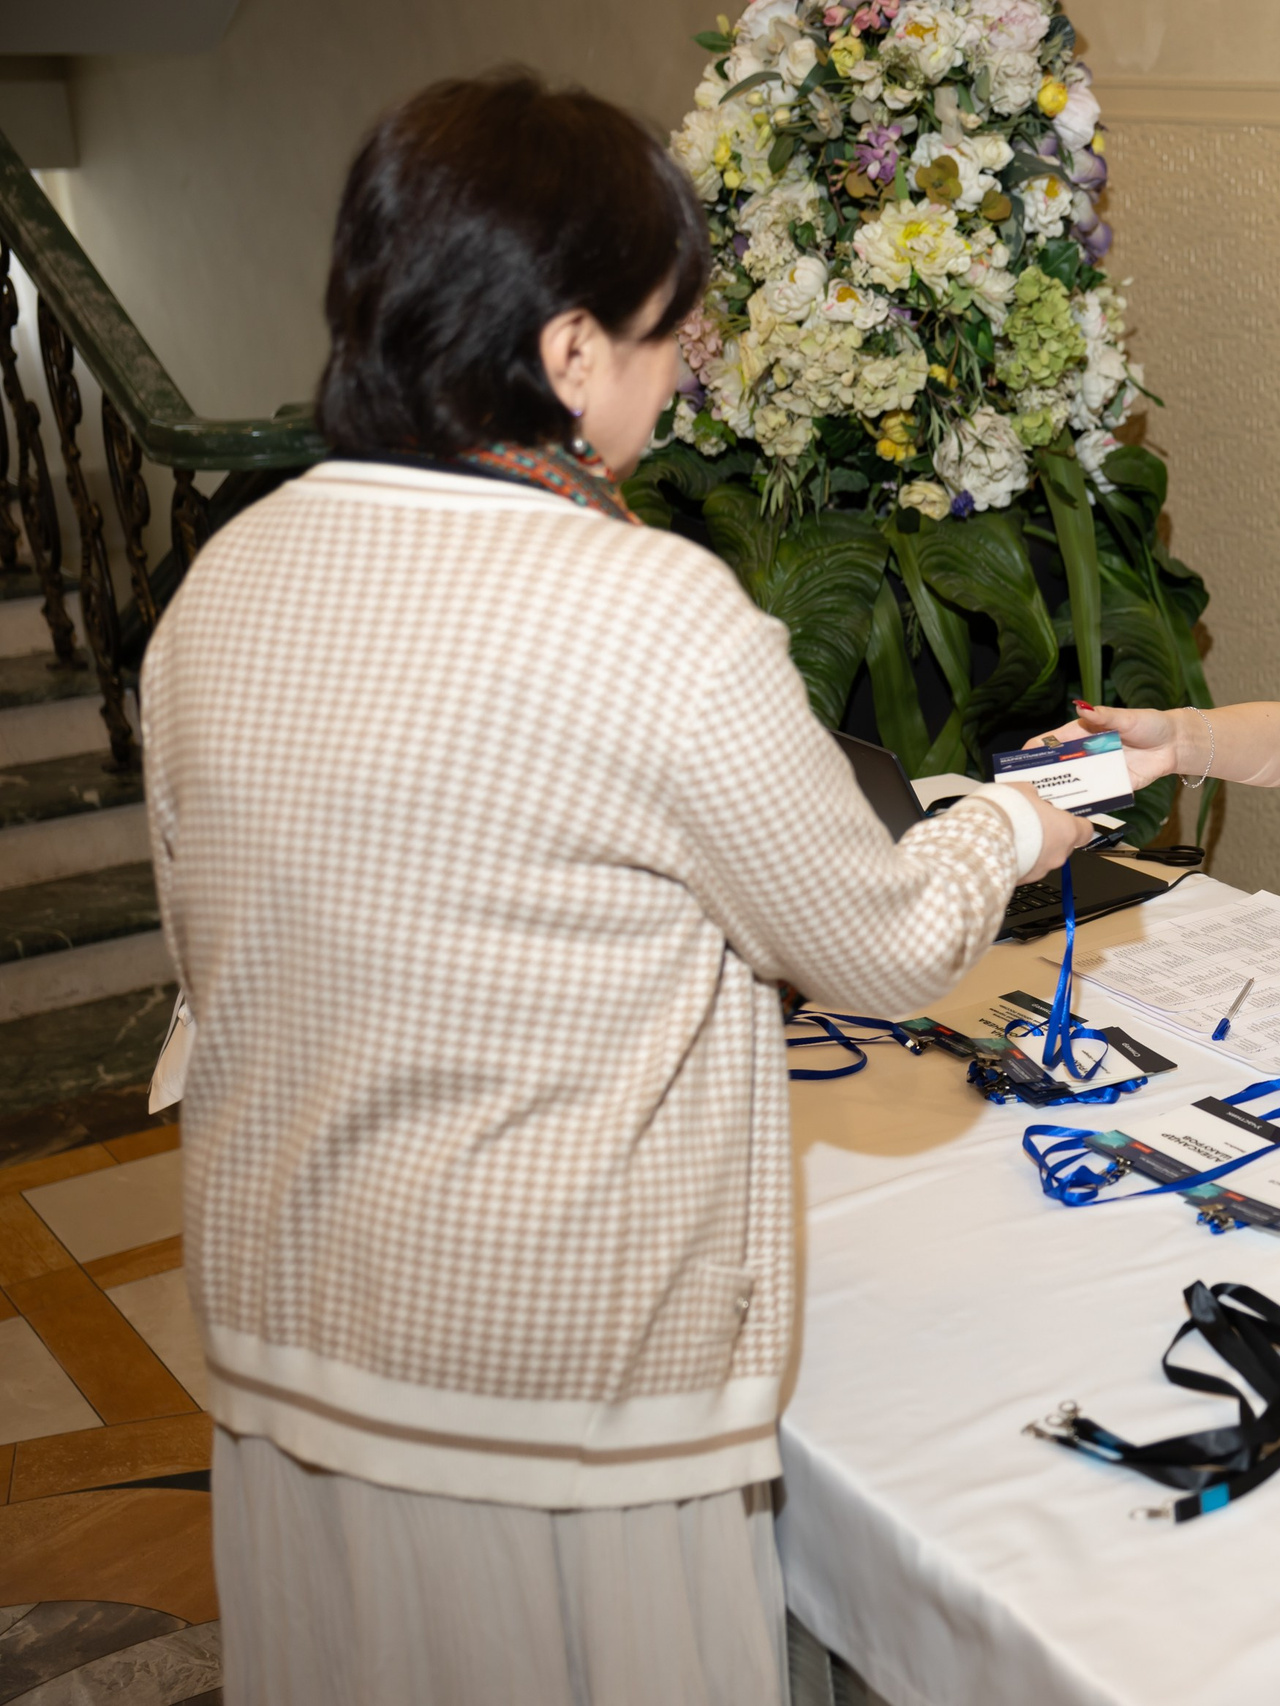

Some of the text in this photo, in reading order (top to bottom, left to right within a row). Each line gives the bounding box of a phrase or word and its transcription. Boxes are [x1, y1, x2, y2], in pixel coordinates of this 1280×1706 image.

[1031, 773, 1072, 785] ЬФИЯ
[1161, 1133, 1225, 1162] АЛЕКСАНДР
[1183, 1135, 1232, 1160] ШАКУРОВ
